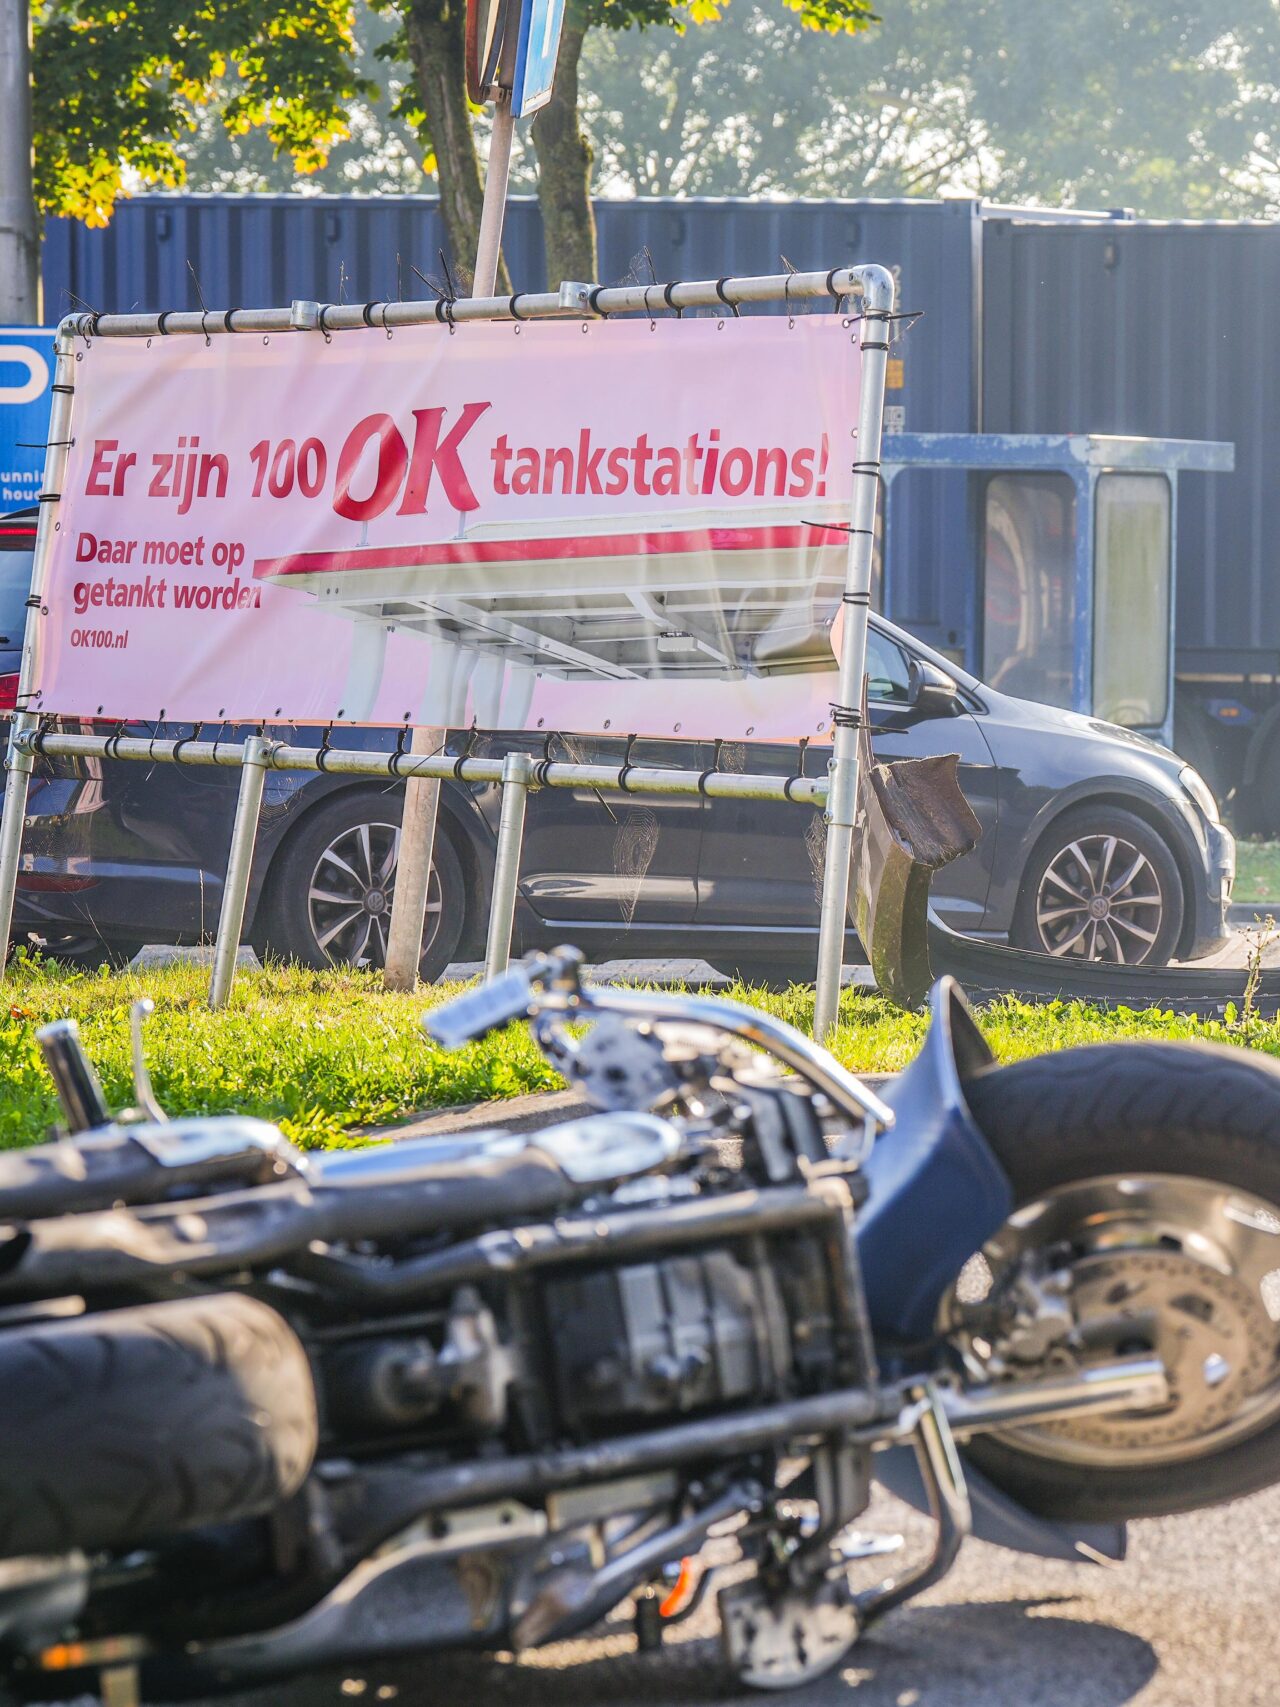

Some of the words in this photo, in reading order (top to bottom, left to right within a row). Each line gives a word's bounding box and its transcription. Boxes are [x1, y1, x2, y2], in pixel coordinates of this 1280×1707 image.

[85, 440, 137, 497] Er
[148, 436, 229, 515] zijn
[249, 437, 327, 498] 100
[332, 402, 493, 522] OK
[490, 428, 829, 497] tankstations!
[75, 532, 137, 564] Daar
[142, 535, 204, 566] moet
[212, 537, 245, 574] op
[73, 575, 167, 615] getankt
[173, 577, 261, 610] worden
[70, 628, 128, 649] OK100.nl
